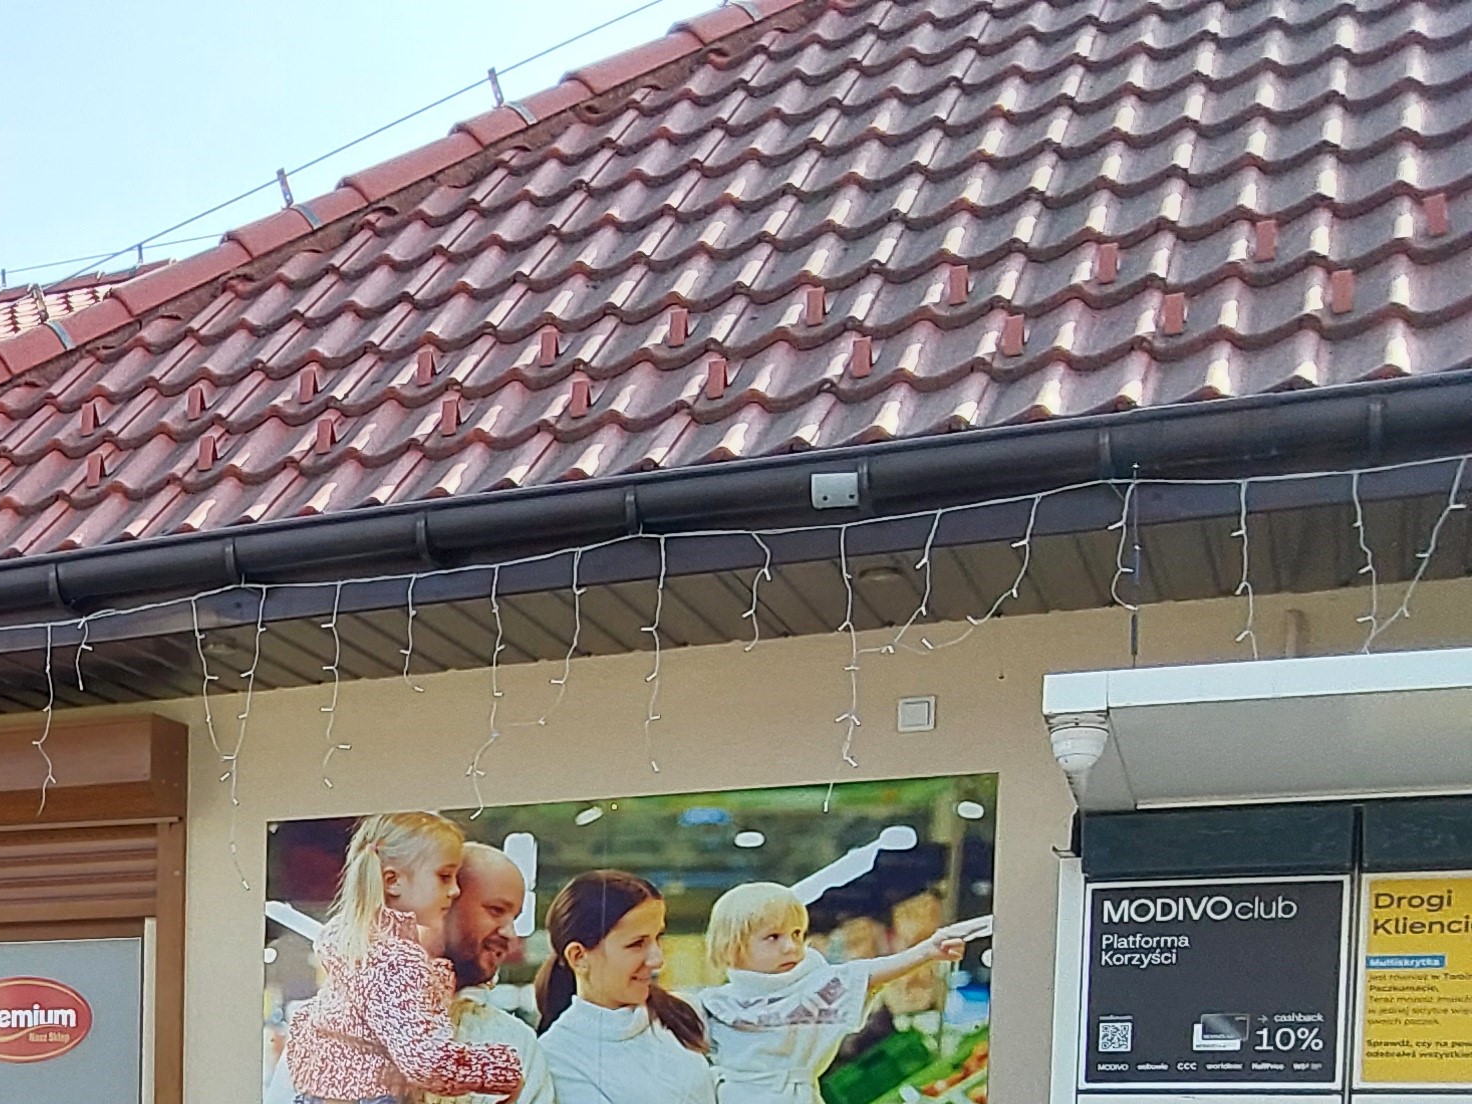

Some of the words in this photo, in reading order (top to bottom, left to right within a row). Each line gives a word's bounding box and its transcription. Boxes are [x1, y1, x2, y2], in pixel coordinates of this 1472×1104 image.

[1374, 889, 1452, 912] Drogi
[1373, 915, 1472, 935] Klienci
[1102, 934, 1190, 949] Platforma
[1101, 948, 1176, 968] Korzyści
[1274, 1012, 1324, 1023] cashback
[1255, 1027, 1324, 1051] 10%
[1177, 1063, 1197, 1071] CCC
